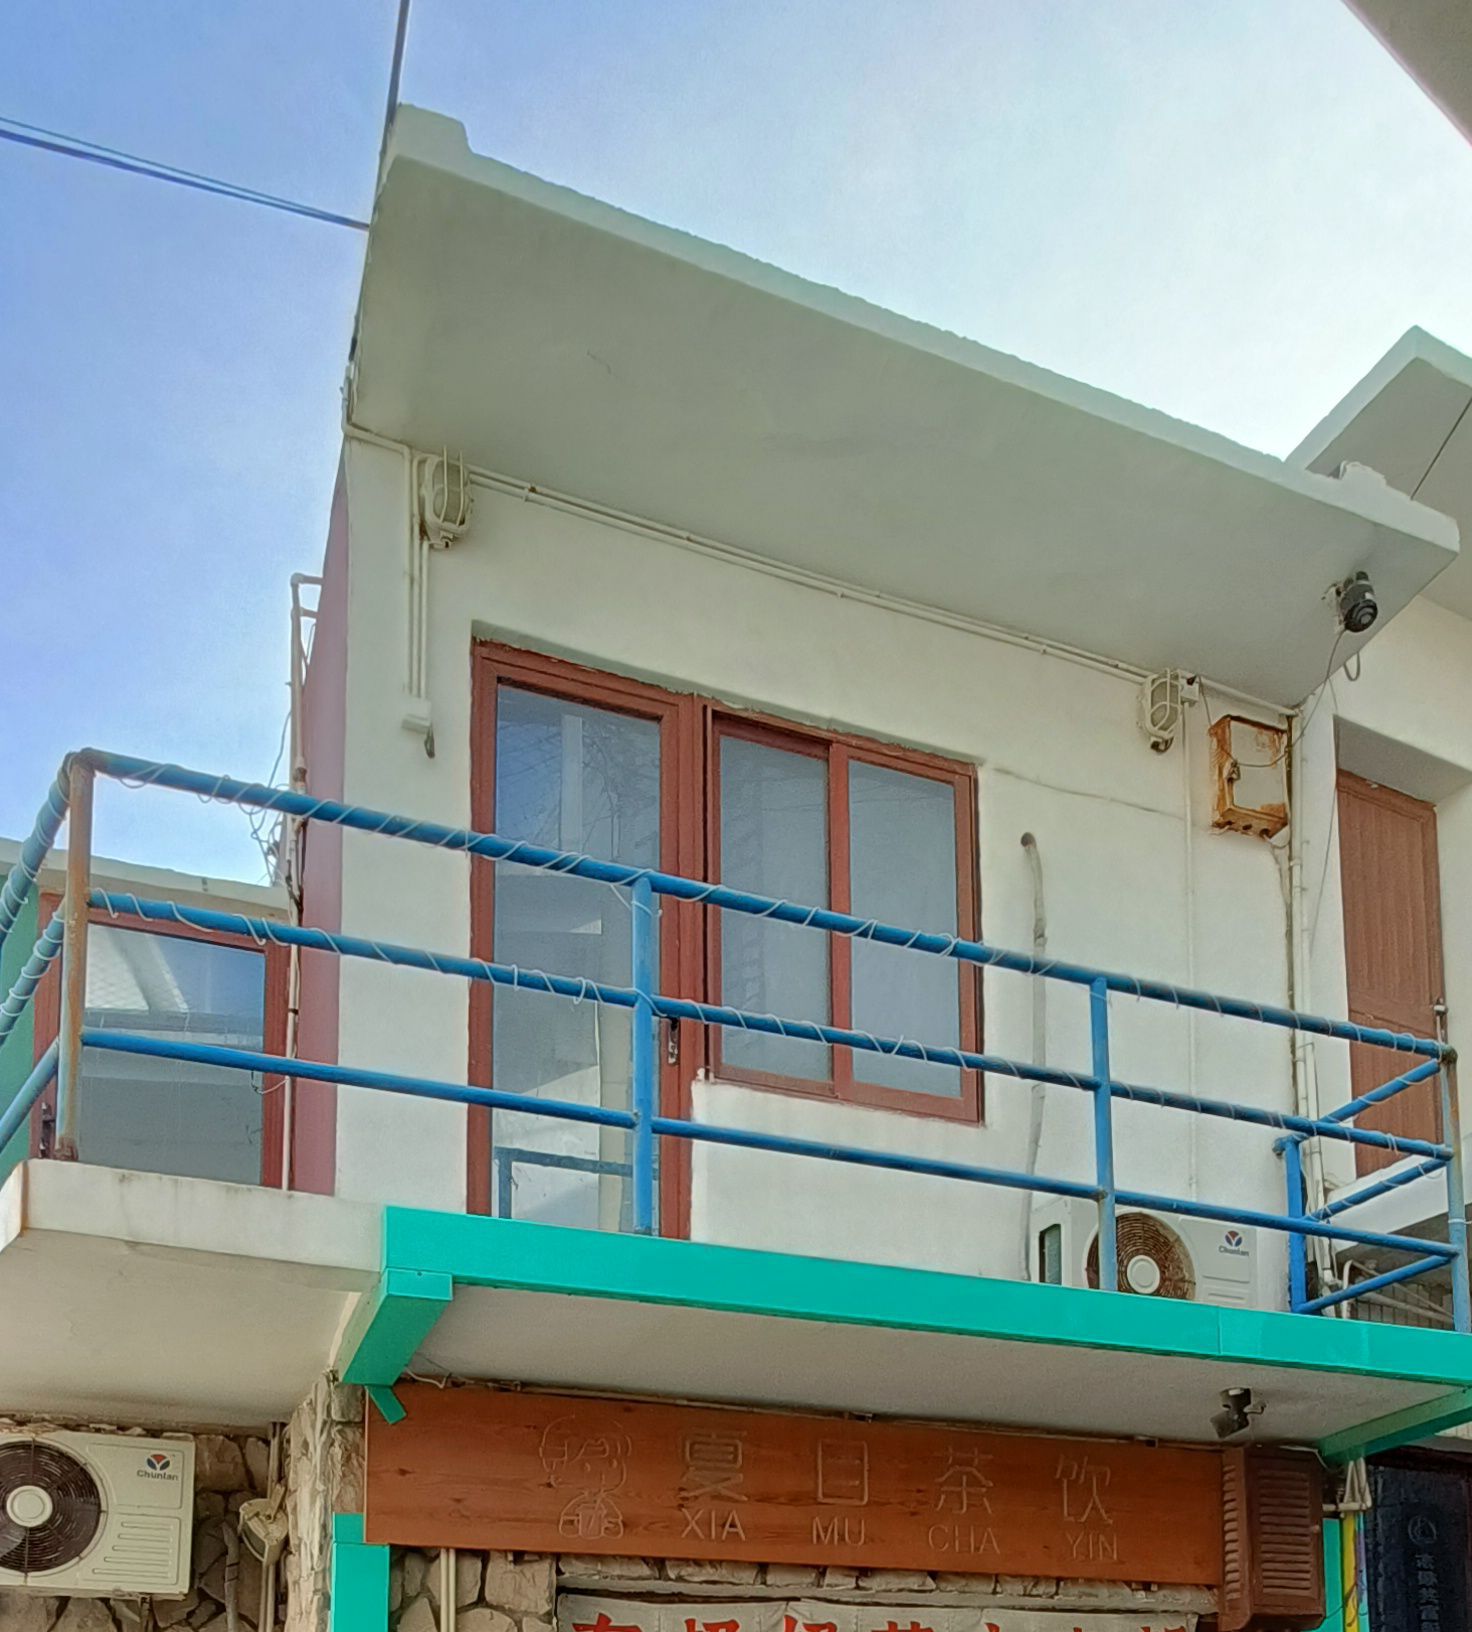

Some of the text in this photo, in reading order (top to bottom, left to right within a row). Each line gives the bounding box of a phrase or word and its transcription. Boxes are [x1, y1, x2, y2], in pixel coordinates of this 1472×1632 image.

[137, 1469, 179, 1480] Chunlan
[680, 1507, 1118, 1561] XIA MU CHA YIN
